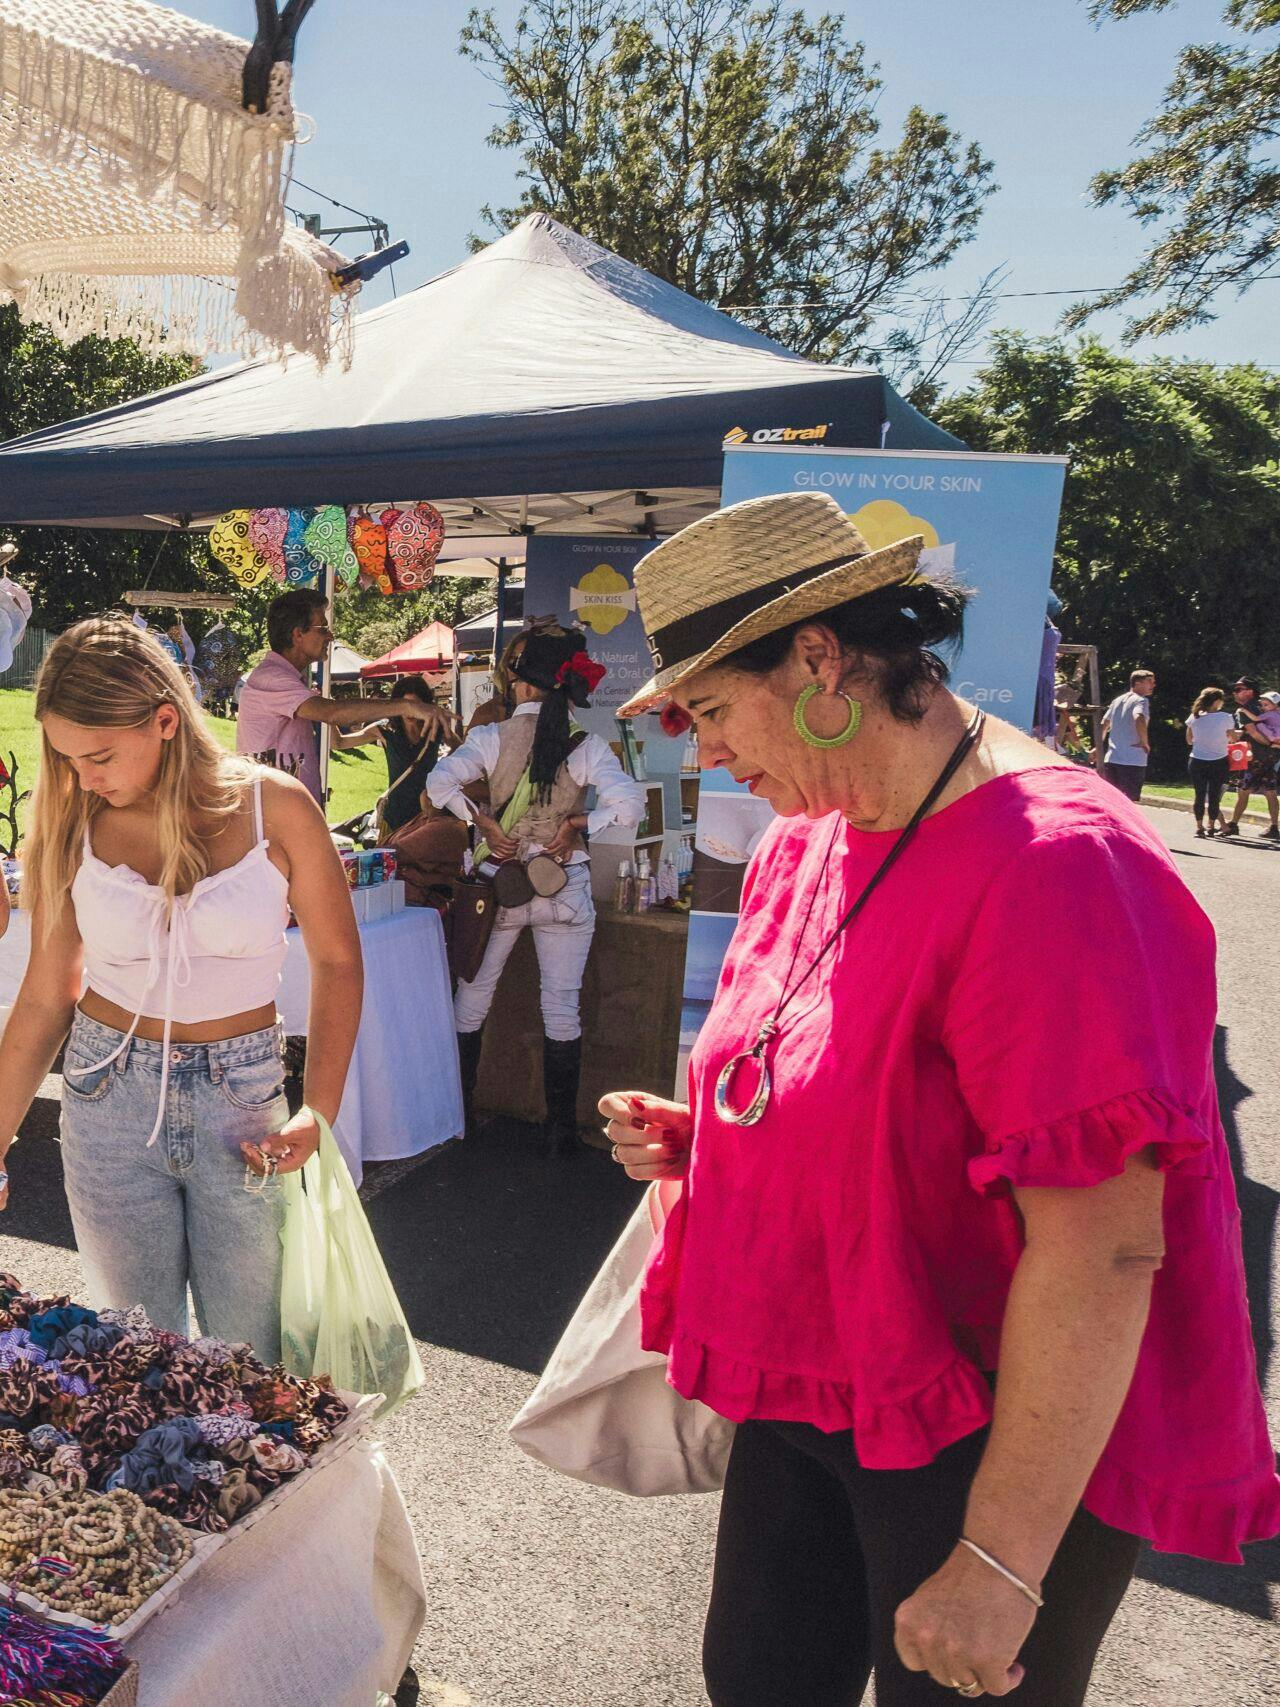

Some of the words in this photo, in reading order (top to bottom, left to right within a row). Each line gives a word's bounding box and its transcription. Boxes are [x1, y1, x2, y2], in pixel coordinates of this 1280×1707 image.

[794, 471, 854, 488] GLOW
[858, 474, 876, 489] IN
[881, 474, 935, 490] YOUR
[940, 476, 982, 493] SKIN
[572, 544, 594, 553] GLOW
[595, 545, 602, 553] IN
[604, 545, 620, 553] YOUR
[622, 545, 638, 553] SKIN
[584, 595, 603, 604] SKIN
[606, 595, 623, 604] KISS
[602, 651, 638, 663] Natural
[607, 667, 617, 679] &
[618, 666, 641, 679] Oral
[956, 681, 1014, 703] Care
